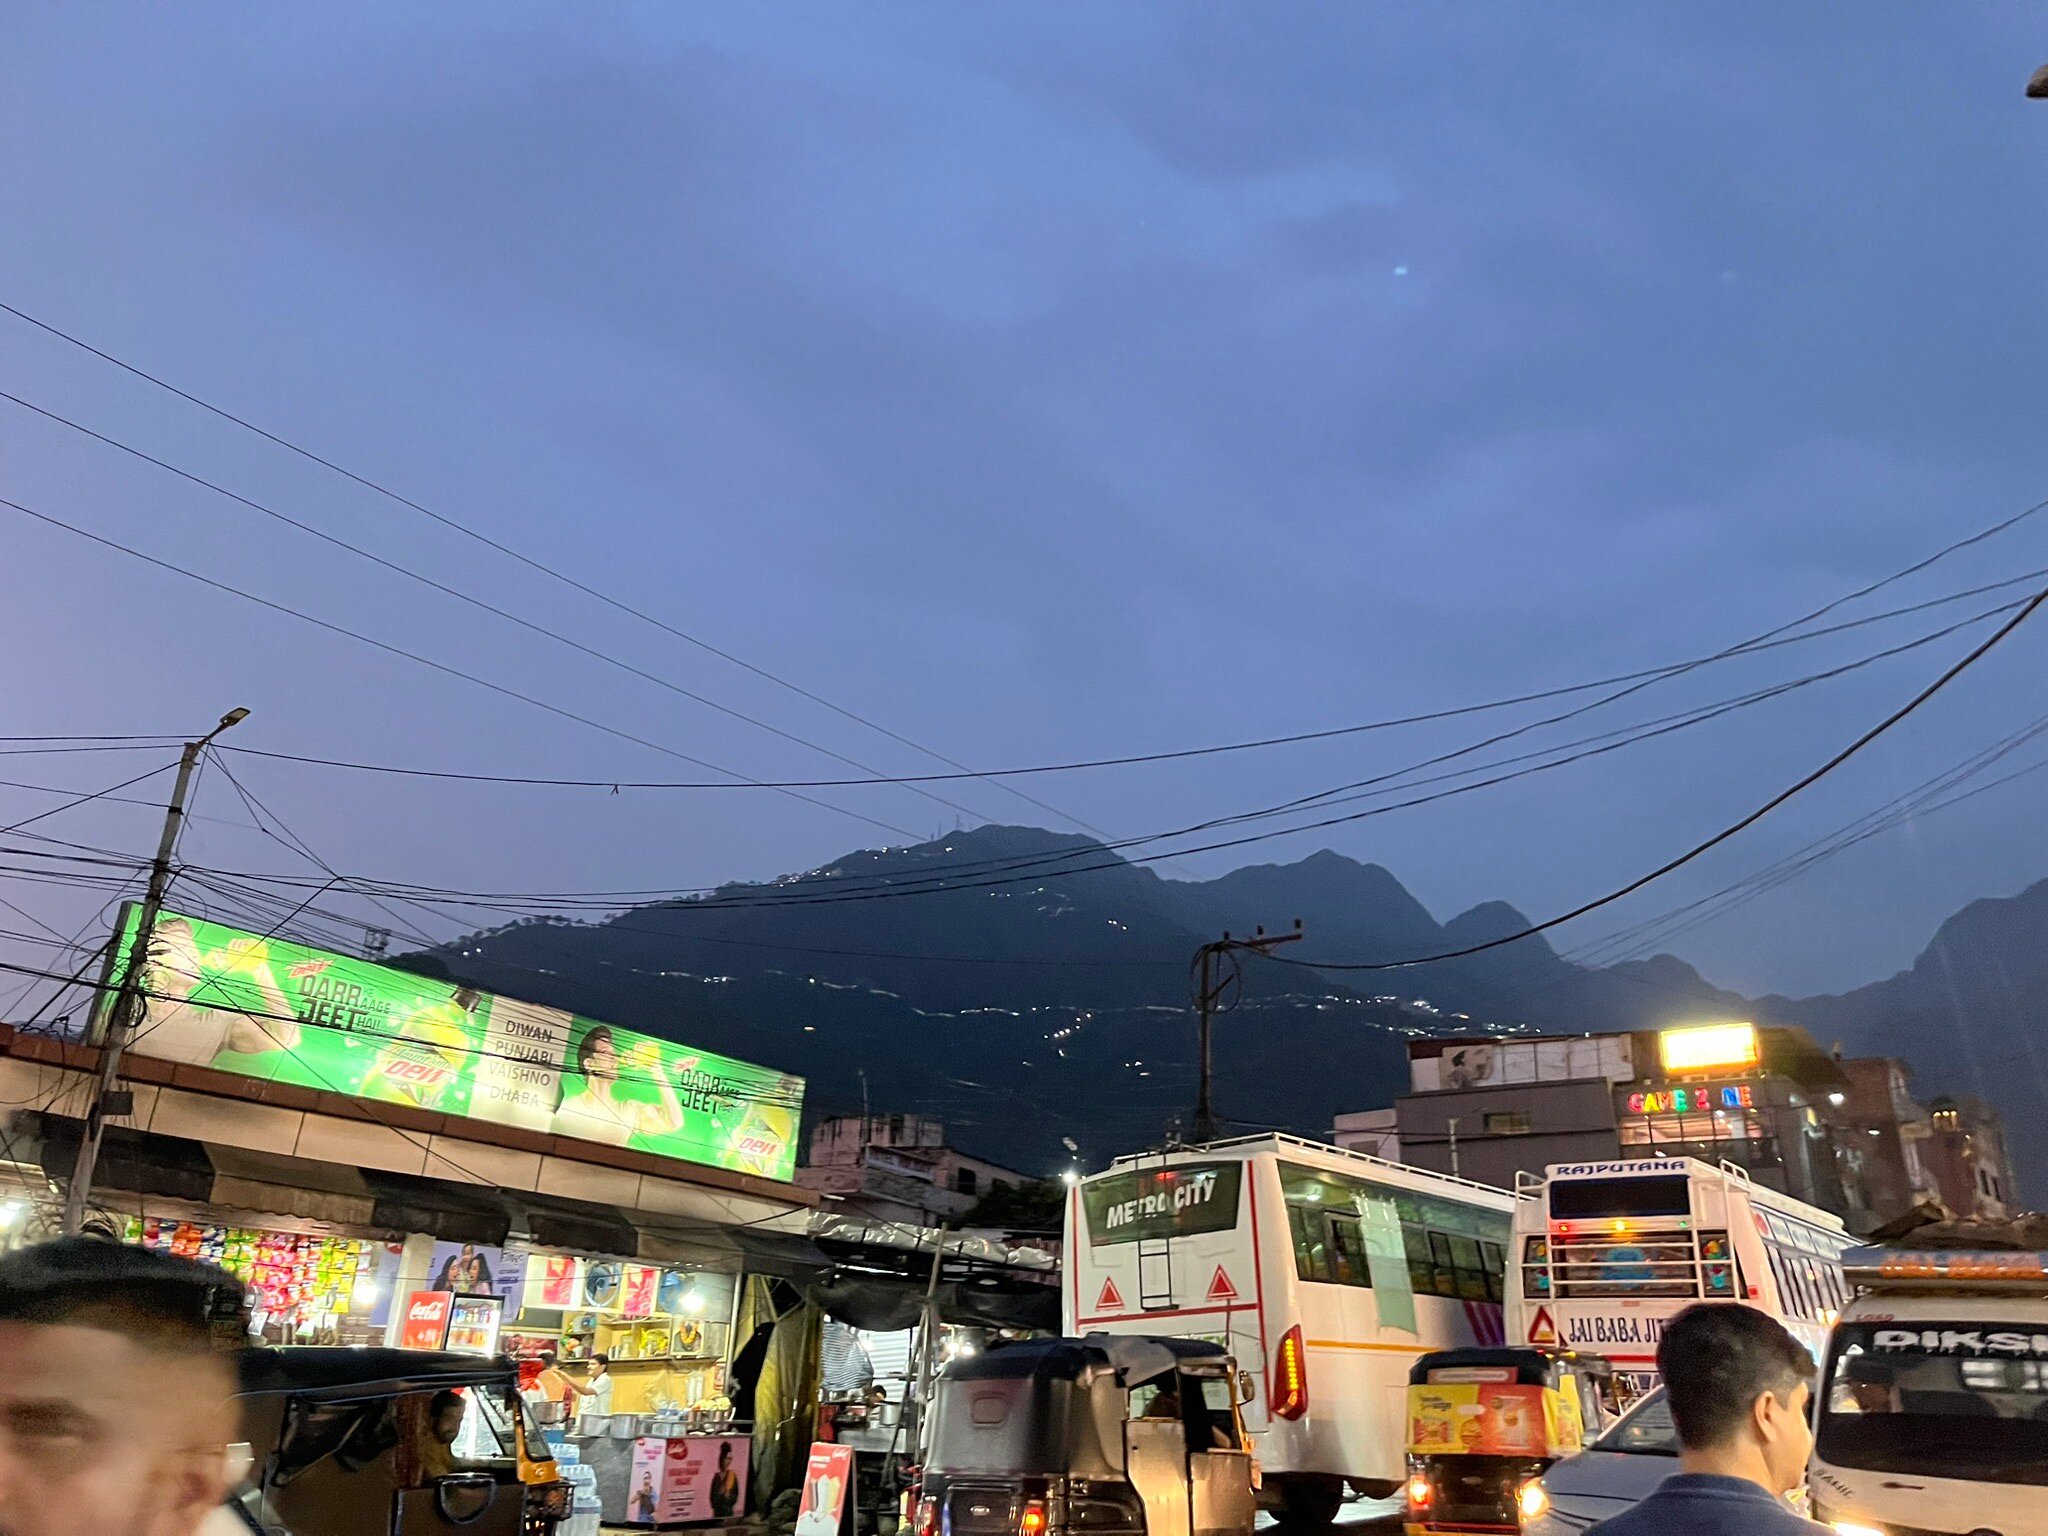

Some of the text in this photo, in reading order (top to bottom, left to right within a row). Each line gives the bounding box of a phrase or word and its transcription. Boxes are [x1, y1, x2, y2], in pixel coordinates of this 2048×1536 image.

[300, 974, 362, 1007] DARR
[298, 997, 369, 1031] JEET
[505, 1020, 553, 1042] DIWAN
[495, 1040, 554, 1064] PUNJABI
[489, 1062, 551, 1086] VAISHNO
[681, 1068, 720, 1094] DARR
[489, 1085, 539, 1107] DHABA
[681, 1087, 718, 1114] JEET
[1627, 1087, 1688, 1114] GAME
[1556, 1160, 1686, 1176] RAJPUTANA
[1106, 1179, 1216, 1229] METRO CITY
[1569, 1317, 1593, 1343] JAI
[1595, 1316, 1641, 1342] BABA
